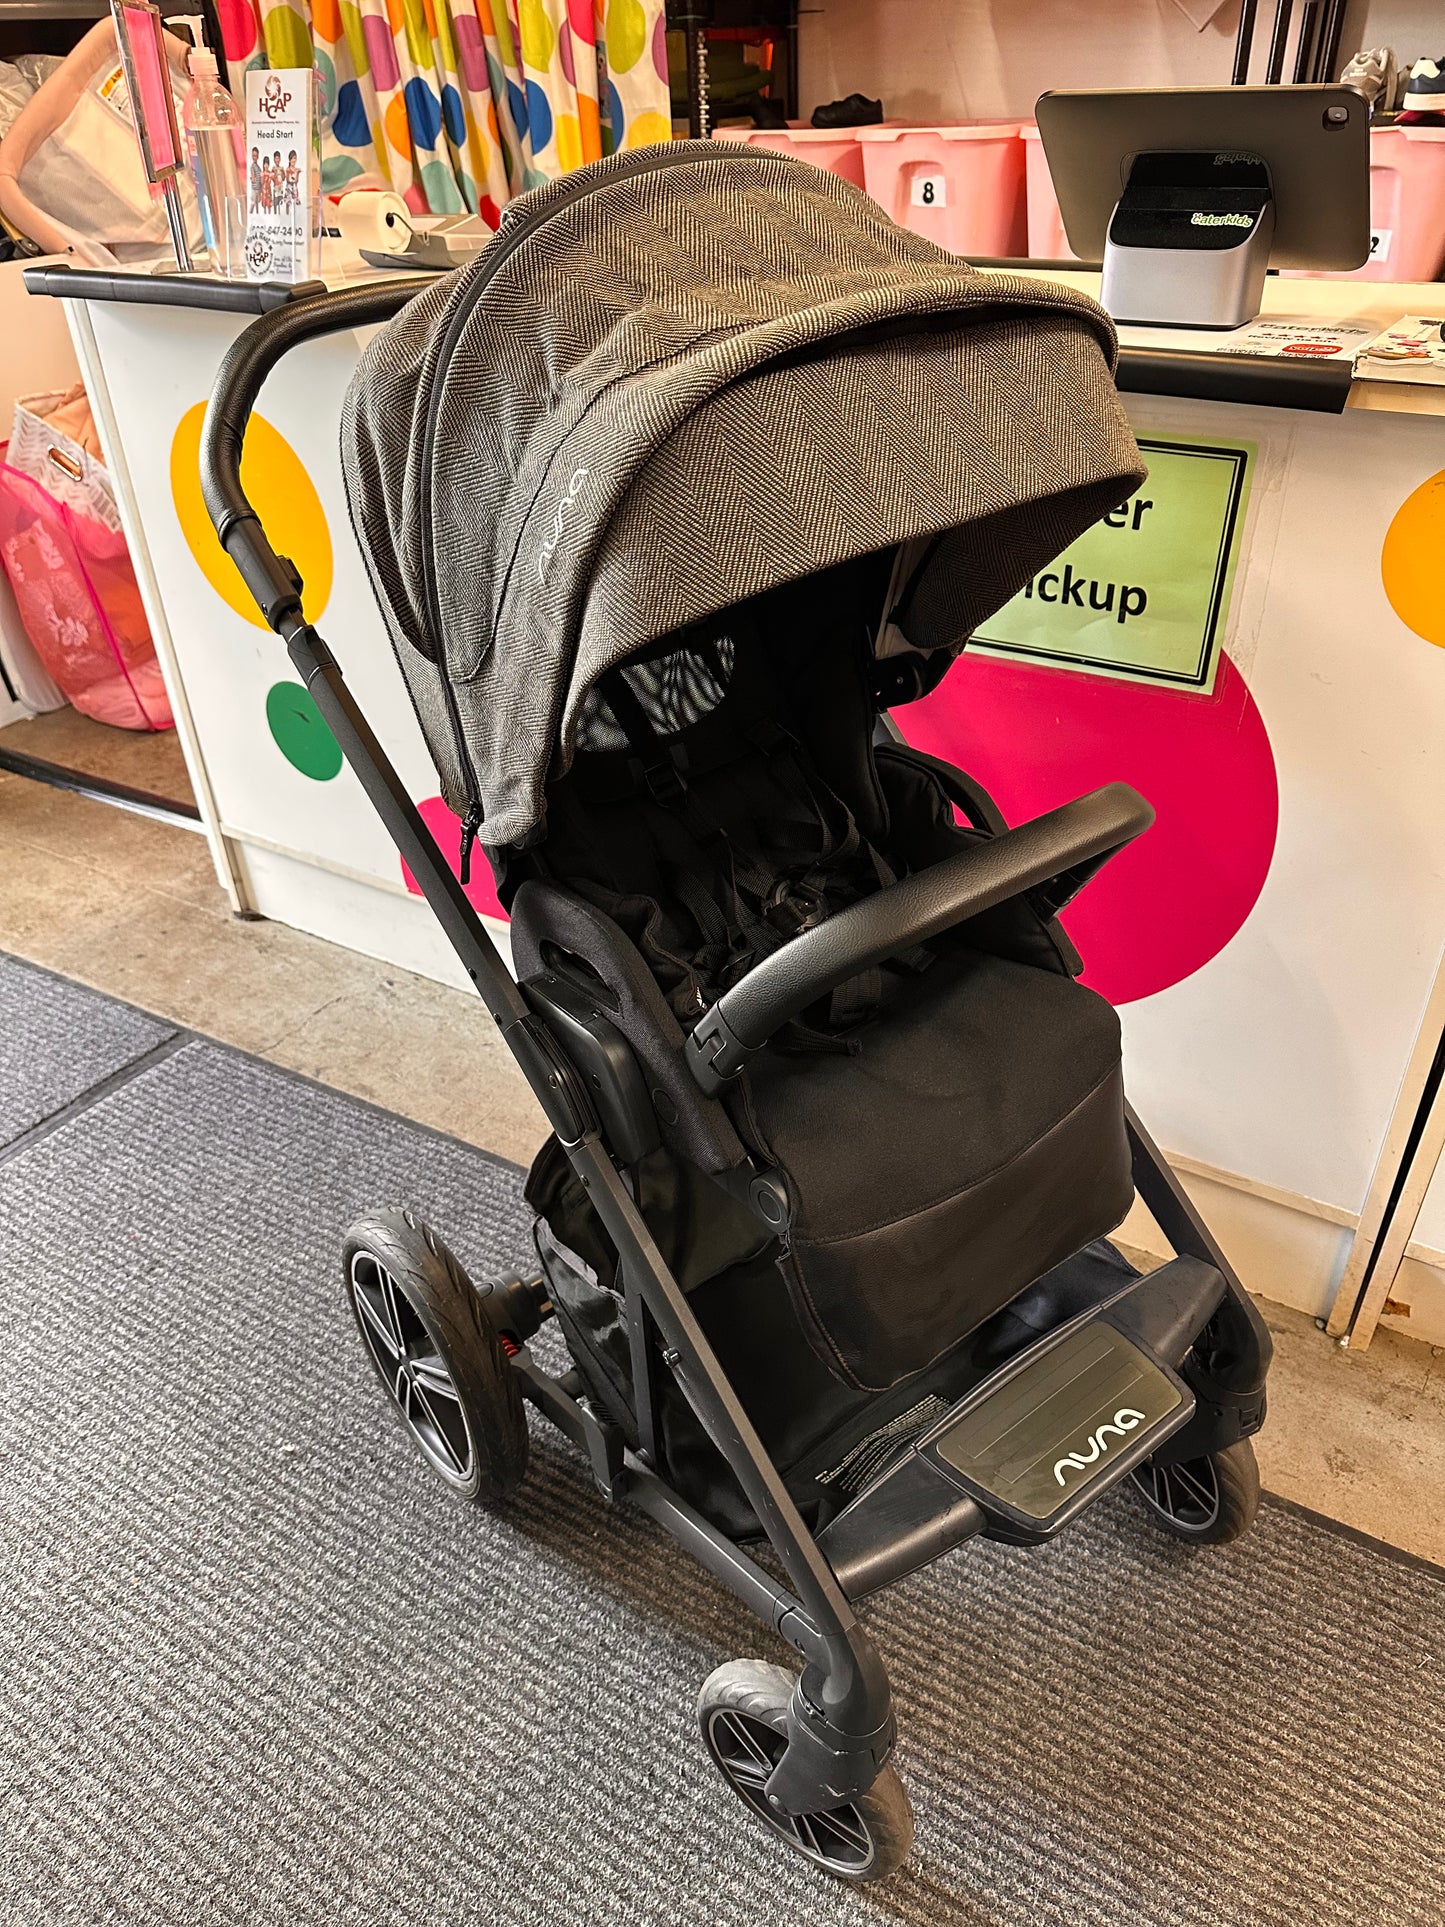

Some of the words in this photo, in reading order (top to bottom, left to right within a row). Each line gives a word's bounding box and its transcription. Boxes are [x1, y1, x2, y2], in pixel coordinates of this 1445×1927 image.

[259, 92, 292, 119] HCAP
[257, 130, 275, 139] Head
[276, 130, 293, 139] Start
[923, 181, 935, 205] 8
[1191, 213, 1253, 228] Caterkids
[539, 468, 588, 586] nuna
[1053, 1408, 1146, 1487] nuna
